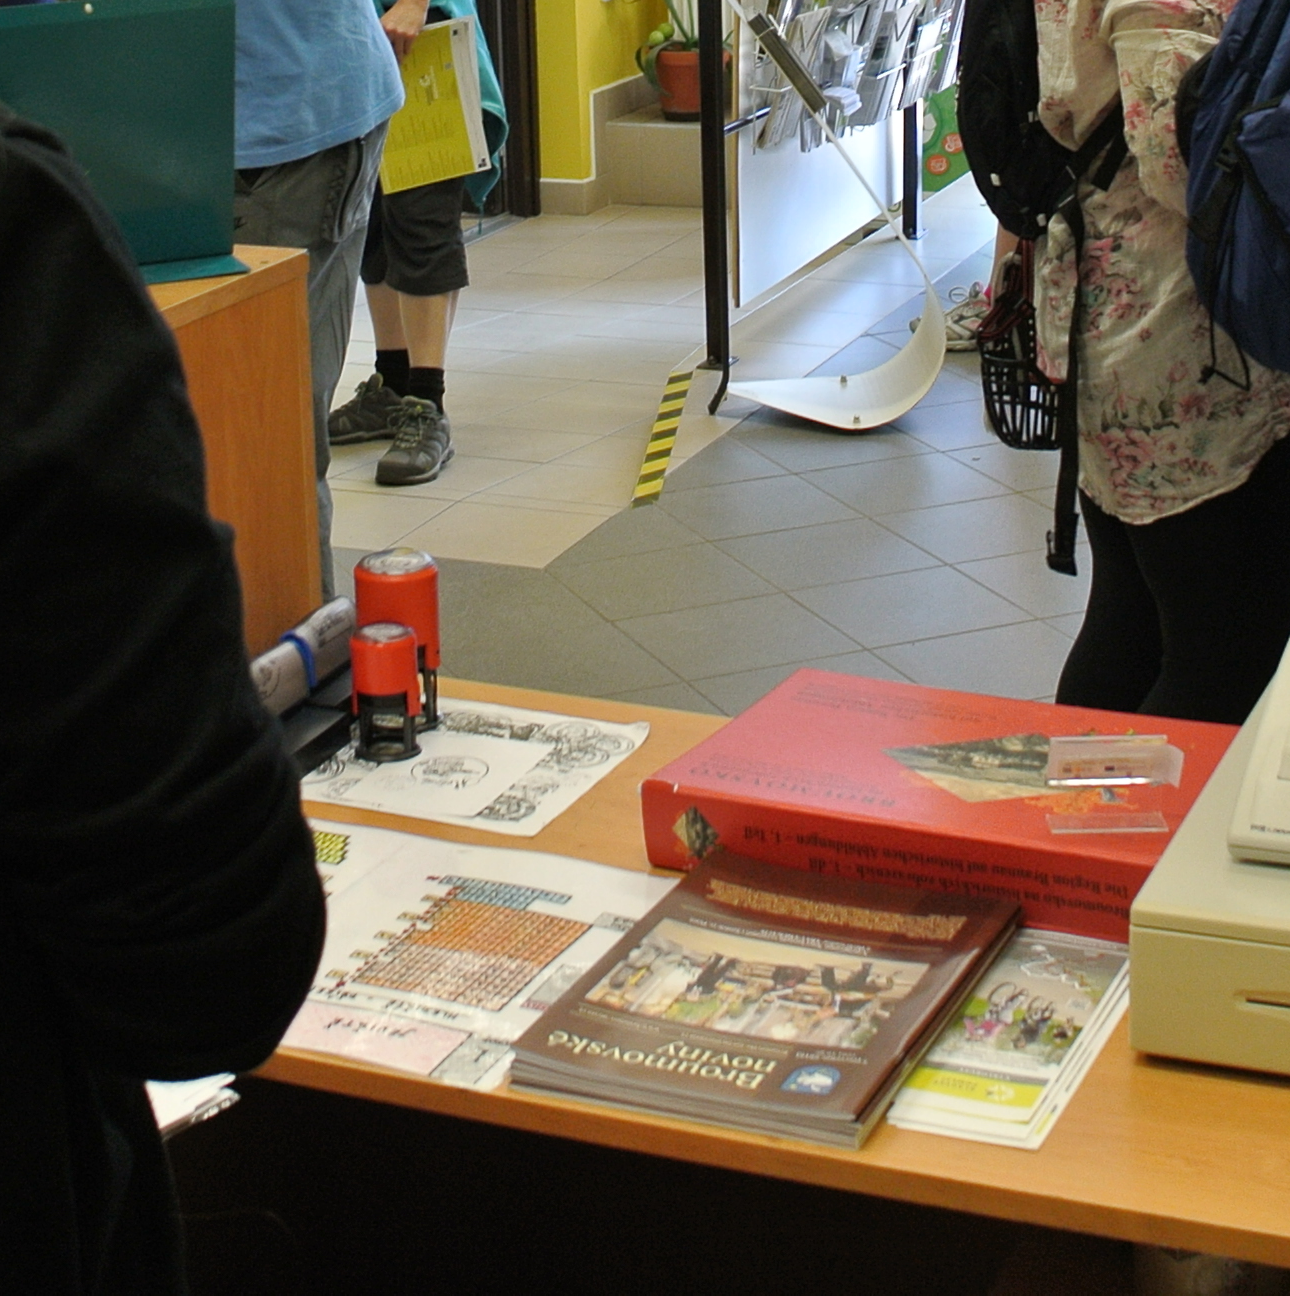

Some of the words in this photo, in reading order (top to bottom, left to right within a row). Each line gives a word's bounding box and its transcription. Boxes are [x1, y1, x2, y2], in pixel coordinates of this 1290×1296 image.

[796, 833, 879, 858] Abbildungen
[883, 848, 965, 873] historischen
[967, 860, 989, 874] auf
[992, 863, 1049, 886] Braunau
[1053, 873, 1102, 895] Region
[1105, 883, 1129, 901] Die
[546, 1029, 766, 1091] Broumovské
[655, 1039, 778, 1074] noviny
